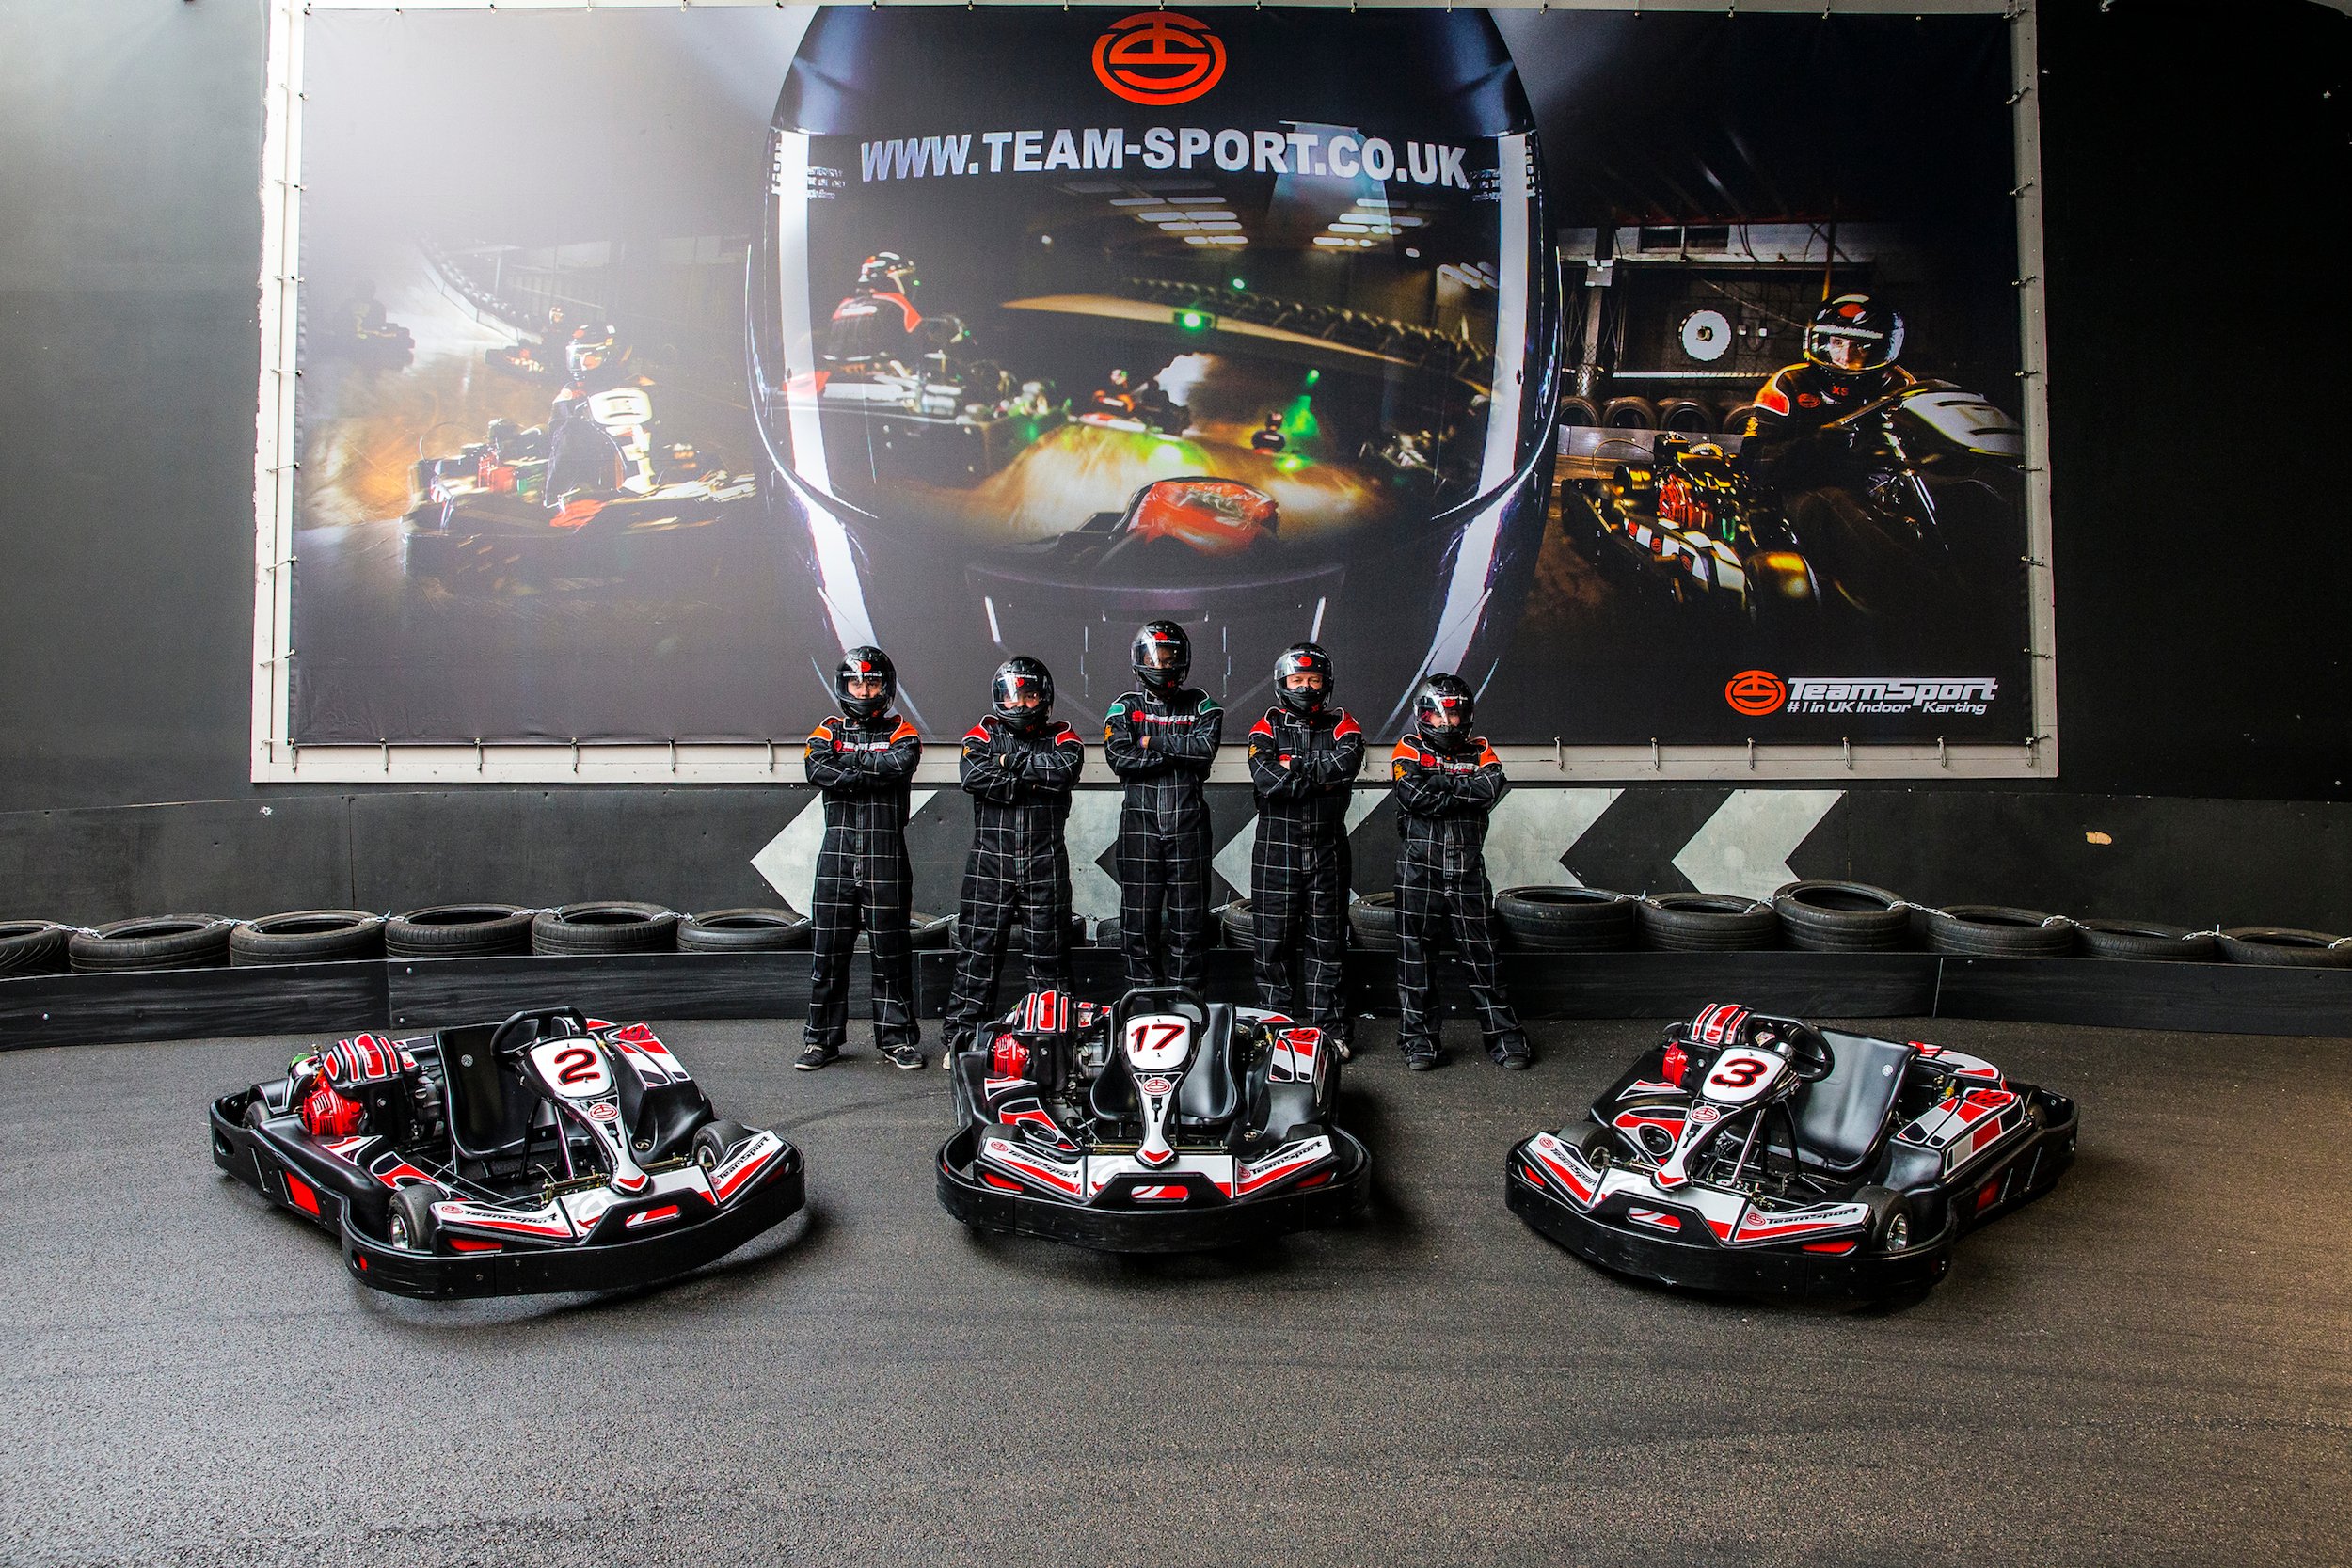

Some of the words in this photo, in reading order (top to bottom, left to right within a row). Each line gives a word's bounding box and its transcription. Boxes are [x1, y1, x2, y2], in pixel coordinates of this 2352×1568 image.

[861, 126, 1470, 189] WWW.TEAM-SPORT.CO.UK
[1787, 676, 1999, 707] TeamSport
[1809, 701, 1826, 713] in
[1826, 701, 1856, 713] UK
[1855, 701, 1912, 713] Indoor
[1921, 701, 1988, 715] Karting
[1131, 1023, 1186, 1053] 17
[554, 1048, 601, 1086] 2
[1710, 1057, 1768, 1088] 3
[717, 1135, 771, 1180] TeamSport
